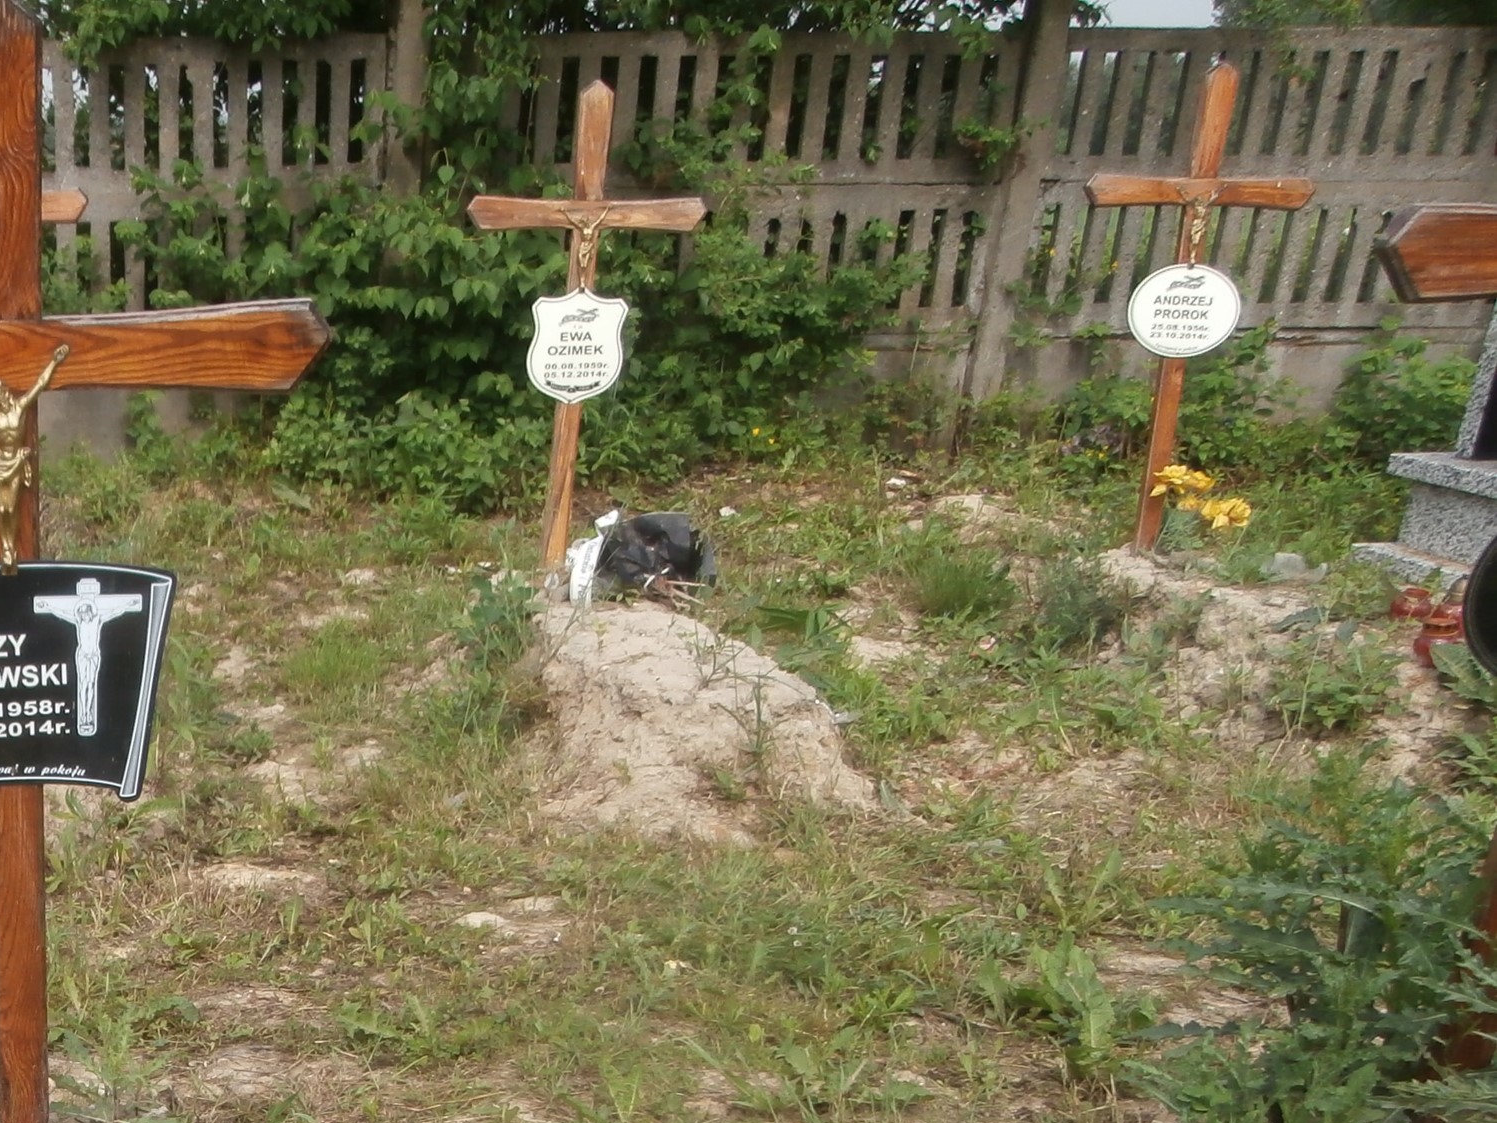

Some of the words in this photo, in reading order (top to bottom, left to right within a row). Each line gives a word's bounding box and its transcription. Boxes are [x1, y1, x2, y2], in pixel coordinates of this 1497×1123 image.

[1153, 295, 1213, 306] ANDRZEJ
[1153, 309, 1209, 320] PROROK
[560, 331, 592, 342] EWA
[547, 345, 603, 356] OZIMEK
[23, 765, 36, 775] w
[41, 764, 86, 778] pokoju
